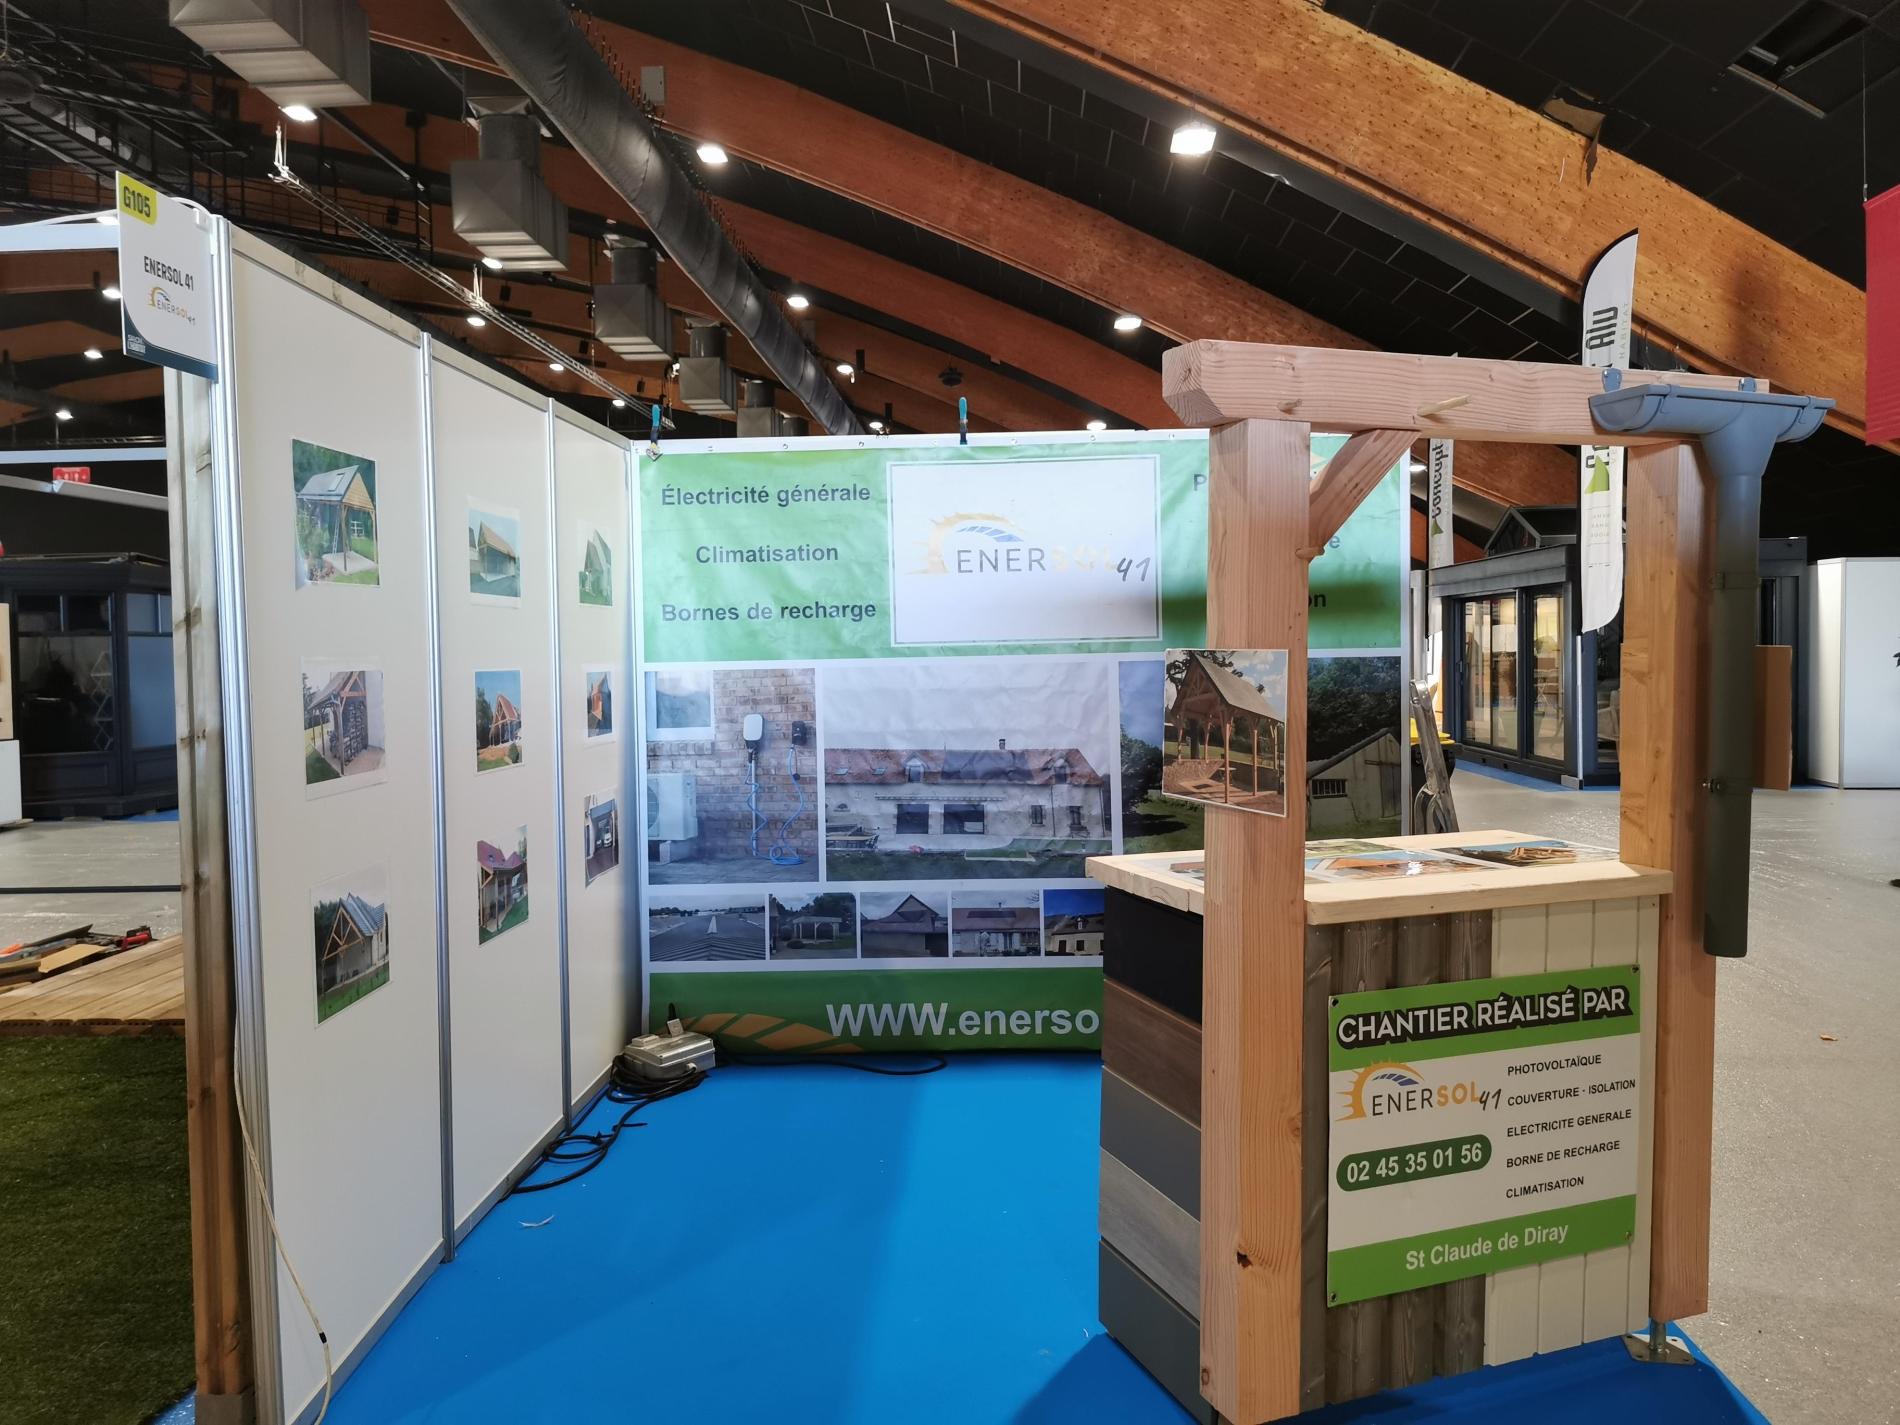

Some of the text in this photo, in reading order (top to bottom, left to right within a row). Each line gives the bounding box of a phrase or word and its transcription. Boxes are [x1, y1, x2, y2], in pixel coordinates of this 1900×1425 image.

[123, 185, 151, 218] G105
[144, 256, 194, 292] ENERSOL 41
[661, 483, 871, 507] Électricité générale
[696, 544, 839, 563] Climatisation
[1116, 557, 1151, 582] 41
[661, 601, 877, 622] Bornes de recharge
[826, 1002, 1100, 1036] WWW.enerso
[1338, 987, 1626, 1043] CHANTIER RÉALISÉ PAR
[1507, 1054, 1602, 1076] PHOTOVOLTAÏQUE
[1372, 1081, 1502, 1116] ENERSOL 41
[1507, 1087, 1579, 1106] COUVERTURE
[1588, 1079, 1636, 1095] ISOLATION
[1507, 1109, 1632, 1137] ELECTRICITE GENERALE
[1347, 1142, 1483, 1183] 02 45 35 01 56
[1506, 1140, 1621, 1168] BORNE DE RECHARGE
[1506, 1176, 1585, 1199] CLIMATISATION
[1405, 1225, 1569, 1270] St Claude de Diray
